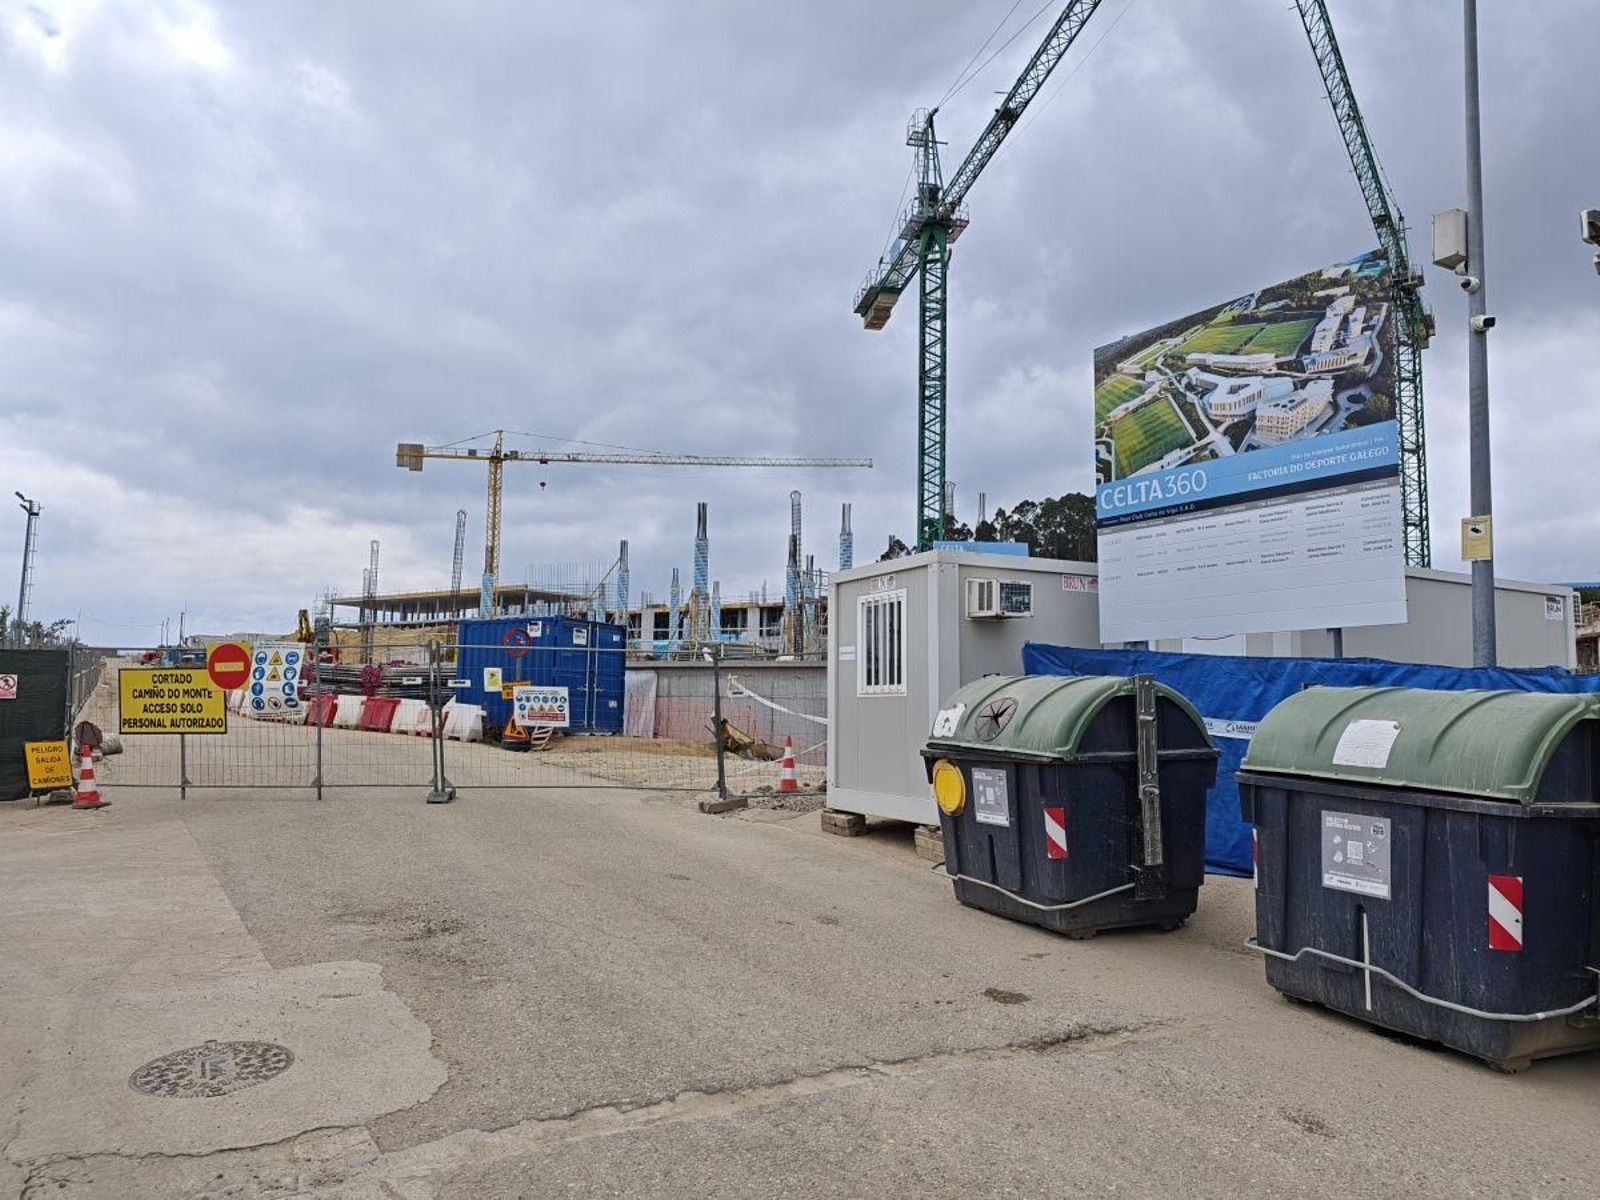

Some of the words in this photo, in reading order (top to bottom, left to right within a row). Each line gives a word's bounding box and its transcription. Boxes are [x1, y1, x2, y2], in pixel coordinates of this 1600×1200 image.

[1290, 462, 1303, 474] DO
[1305, 453, 1347, 470] DEPORTE
[1350, 446, 1390, 461] GALEGO
[1063, 575, 1086, 590] BRUN
[152, 674, 192, 684] CORTADO
[132, 685, 165, 699] CAMIÑO
[167, 688, 180, 699] DO
[182, 688, 213, 699] MONTE
[142, 703, 178, 713] ACCESO
[179, 703, 203, 713] SOLO
[122, 718, 167, 728] PERSONAL
[170, 717, 224, 728] AUTORIZADO
[35, 756, 62, 764] SALIDA
[32, 776, 70, 784] CAMIONES
